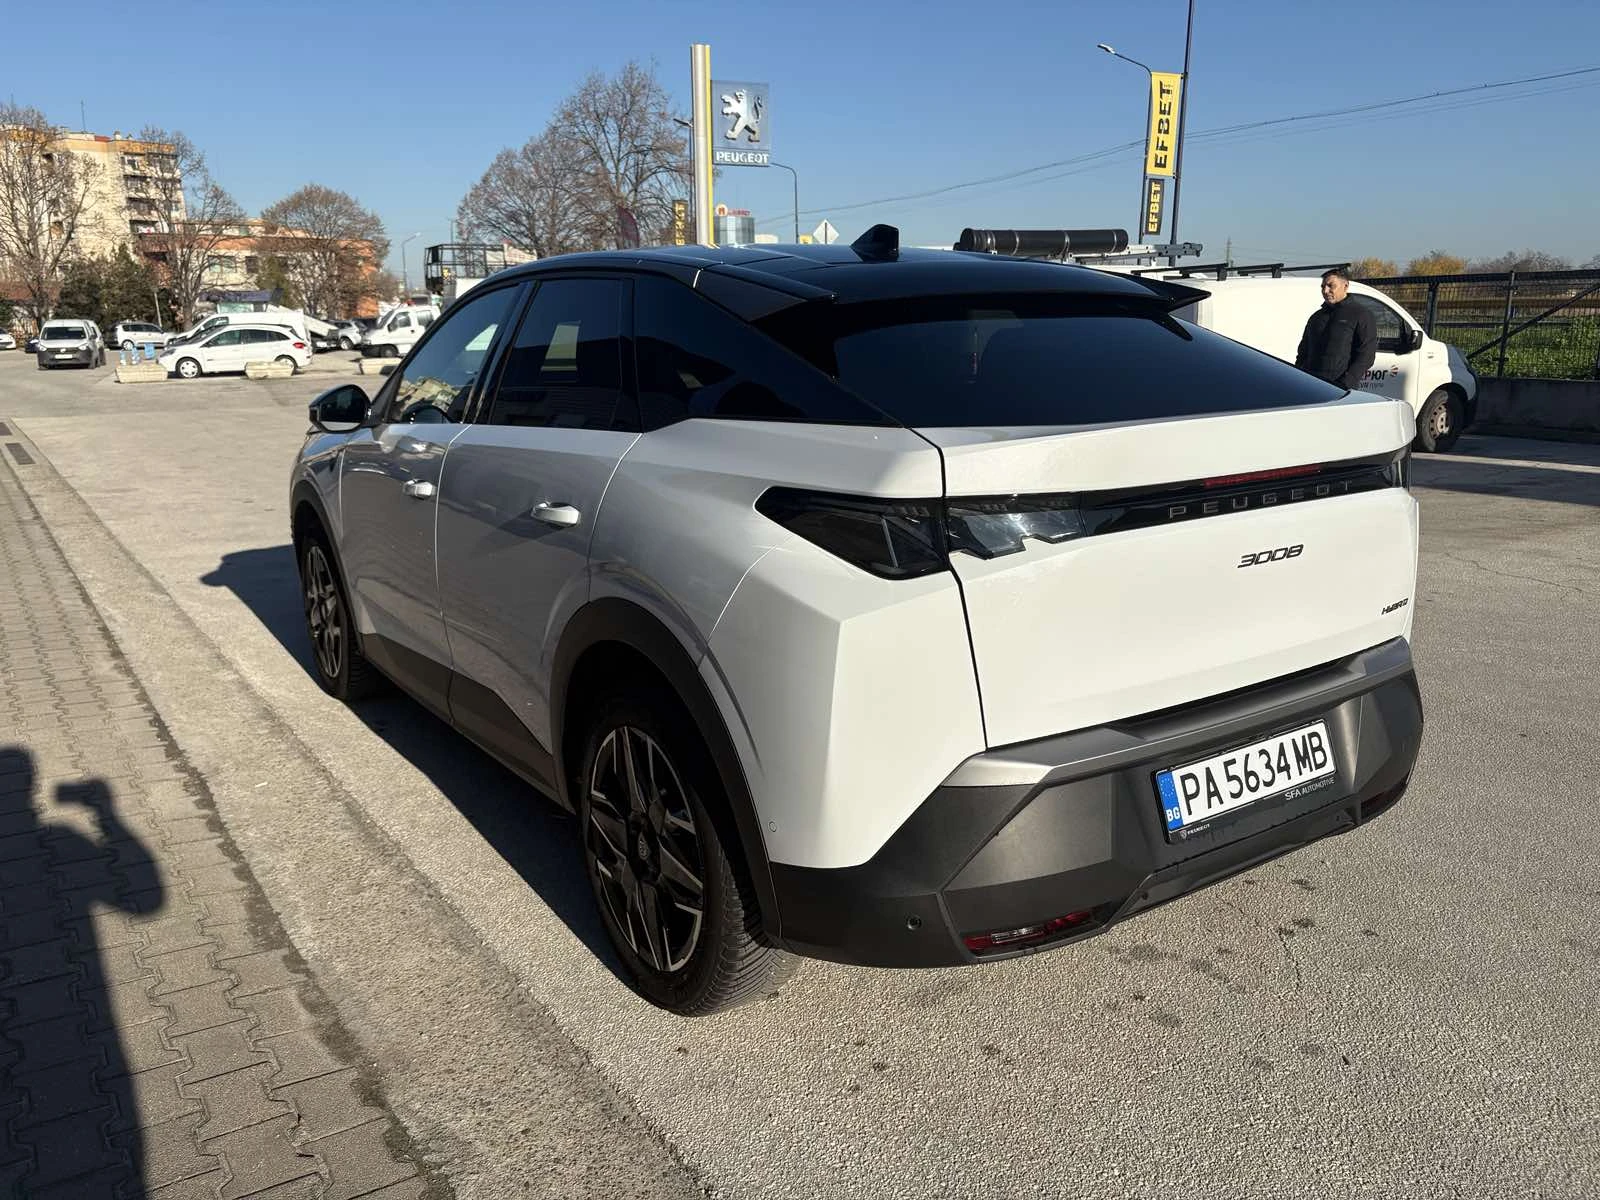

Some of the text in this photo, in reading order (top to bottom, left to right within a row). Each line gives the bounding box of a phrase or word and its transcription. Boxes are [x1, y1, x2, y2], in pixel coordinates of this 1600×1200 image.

[1154, 80, 1174, 169] EFBET
[715, 151, 769, 164] PEUGEOT
[1148, 182, 1162, 233] EFBET
[1169, 480, 1352, 519] PEUGEOT
[1237, 543, 1304, 569] 3008
[1180, 731, 1328, 816] PA 5634 MB
[1284, 777, 1335, 801] SFA AUTOMOTIVE
[1165, 806, 1181, 822] BG
